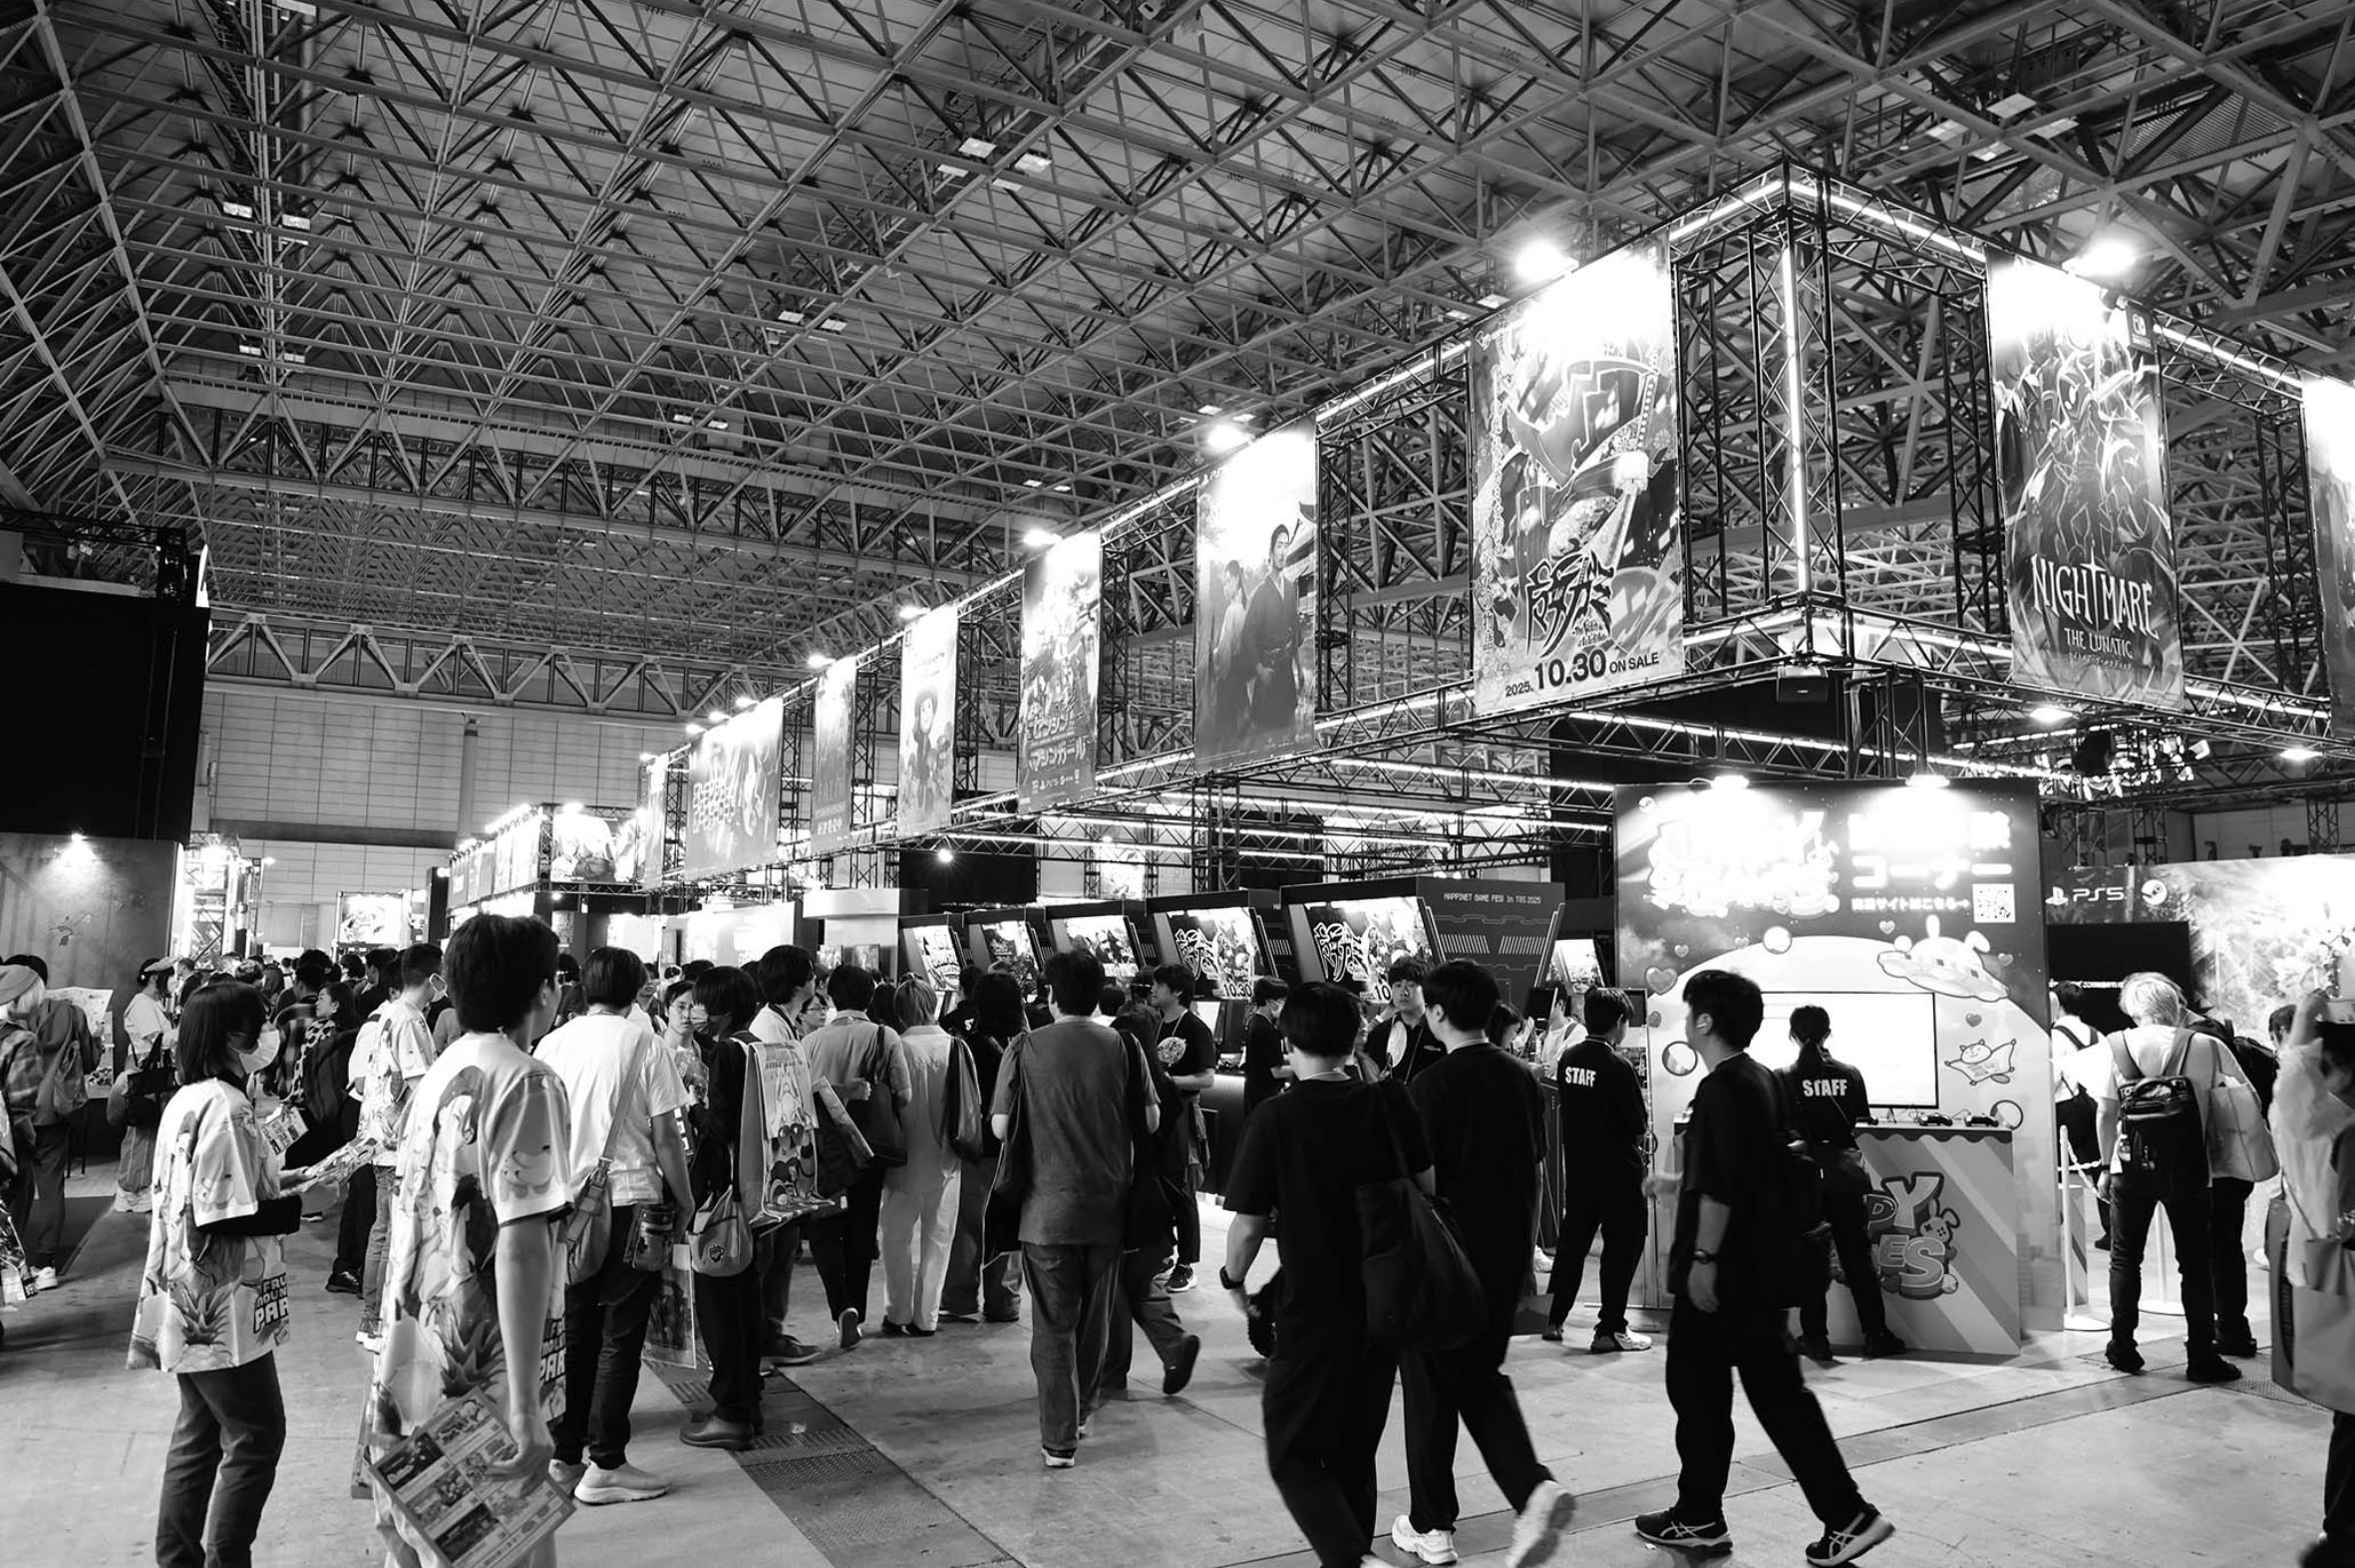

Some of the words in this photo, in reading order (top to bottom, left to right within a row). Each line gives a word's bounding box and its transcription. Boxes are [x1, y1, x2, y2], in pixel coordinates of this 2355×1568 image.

[2031, 546, 2160, 640] NIGHTMARE
[2064, 627, 2087, 650] THE
[2089, 633, 2133, 659] LUNATIC
[1506, 681, 1533, 697] 2025.
[1535, 649, 1606, 690] 10.30
[1609, 661, 1626, 674] ON
[1628, 652, 1659, 670] SALE
[2073, 887, 2125, 902] PS5
[1565, 1066, 1596, 1088] STAFF
[1803, 1079, 1848, 1097] STAFF
